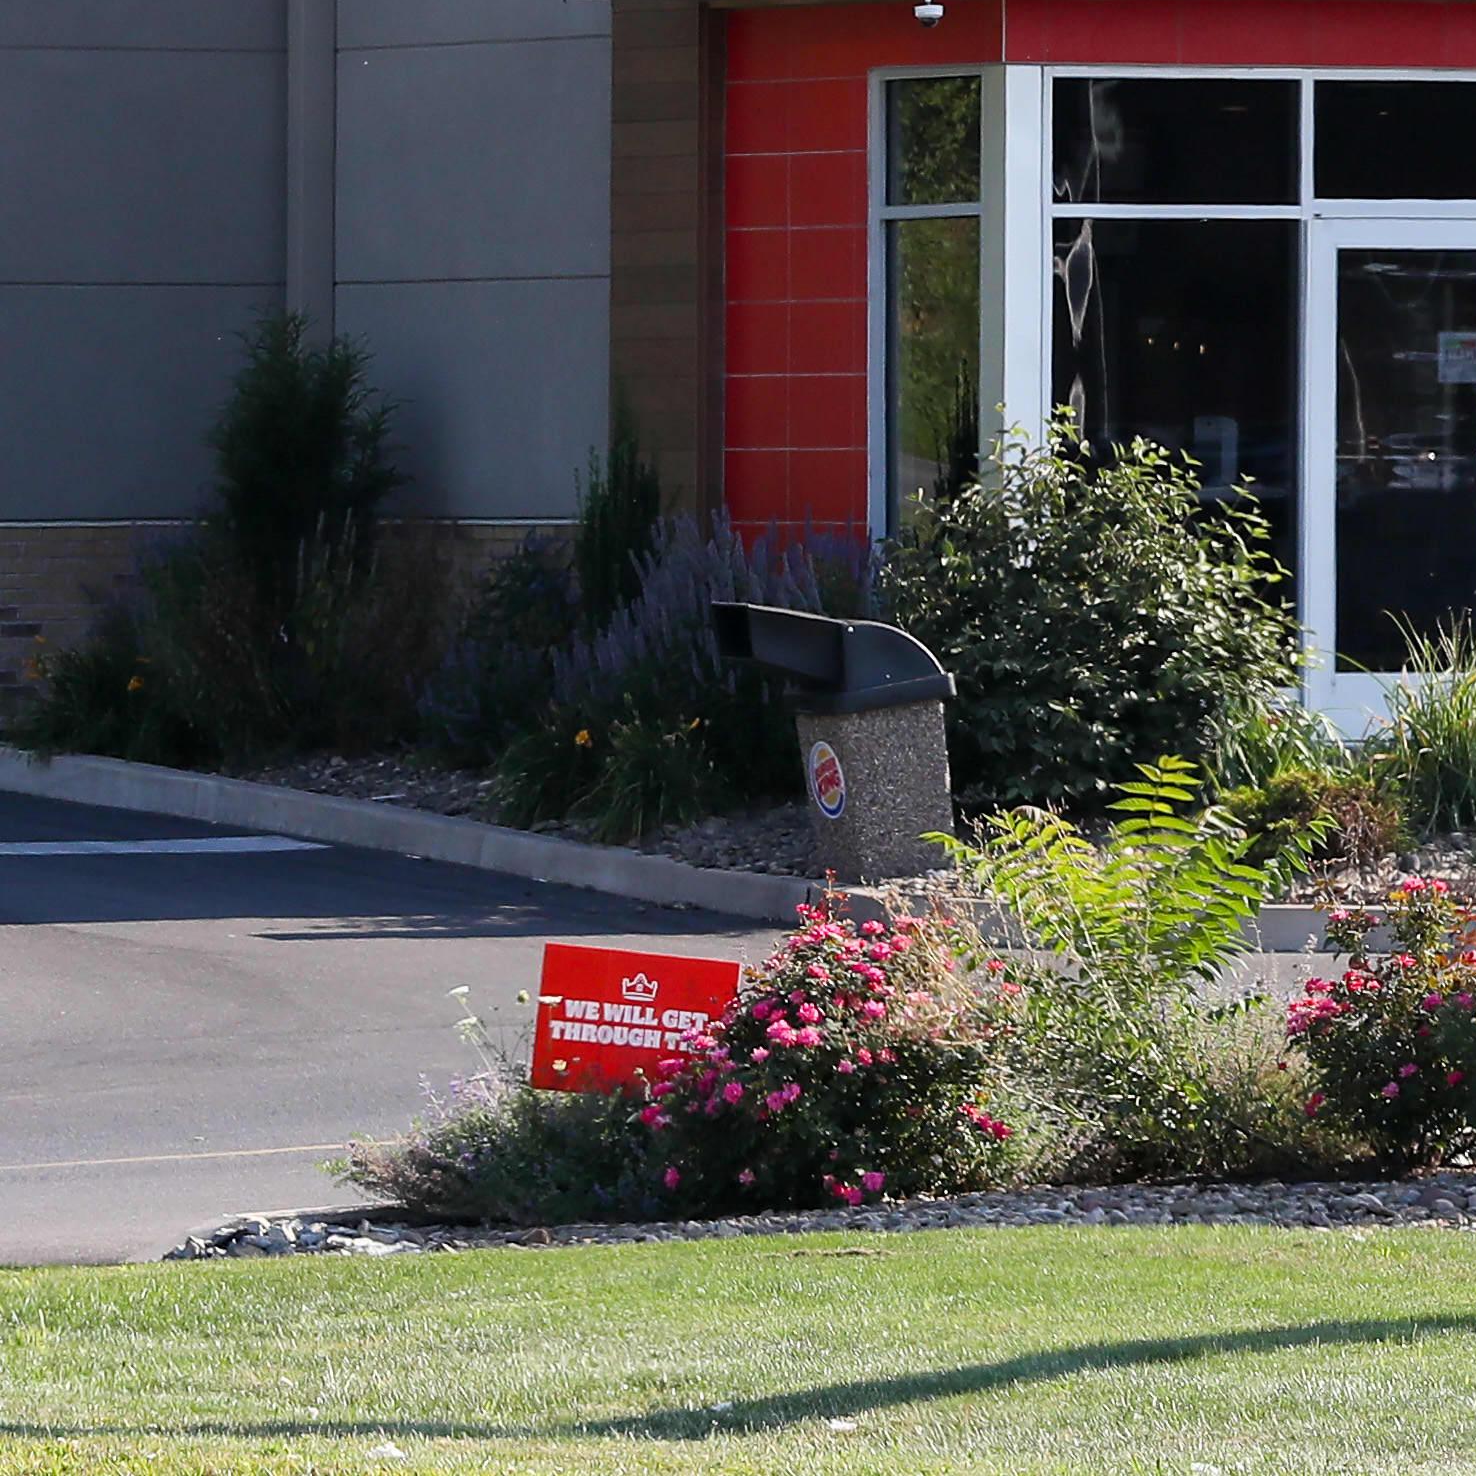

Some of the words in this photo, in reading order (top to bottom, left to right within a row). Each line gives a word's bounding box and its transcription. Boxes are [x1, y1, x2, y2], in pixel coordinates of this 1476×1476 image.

[564, 999, 600, 1020] WE
[602, 1002, 658, 1026] WILL
[661, 1009, 709, 1031] GET
[550, 1019, 662, 1048] THROUGH
